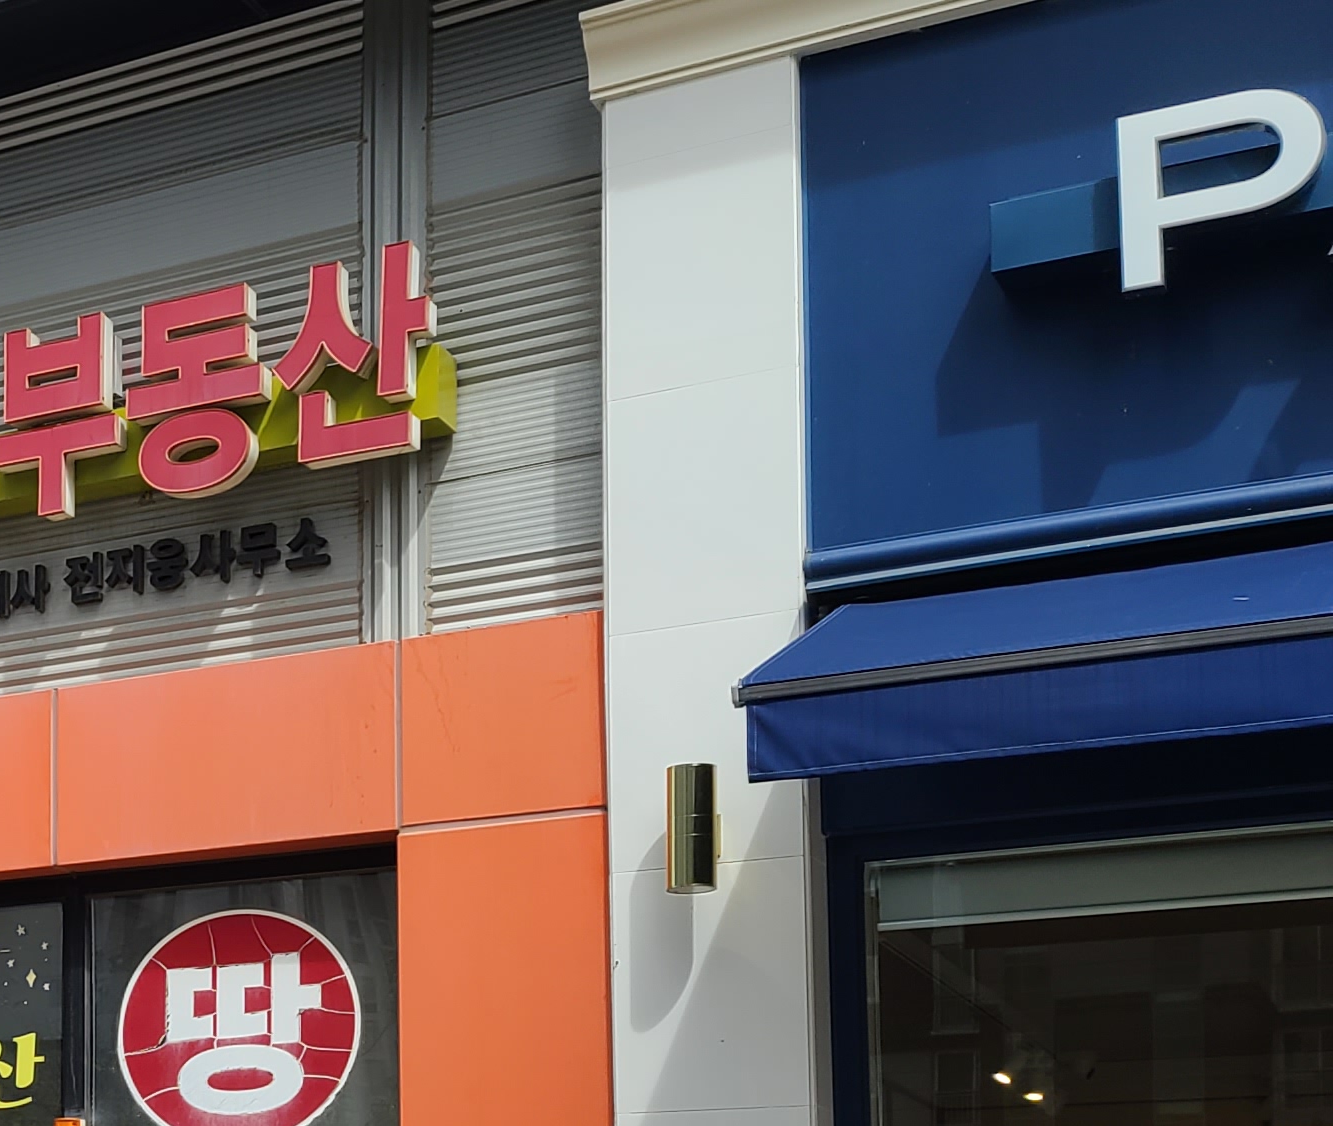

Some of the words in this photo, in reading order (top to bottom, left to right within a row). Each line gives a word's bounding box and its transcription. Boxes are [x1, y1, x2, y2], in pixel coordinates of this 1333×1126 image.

[1116, 87, 1333, 293] P
[63, 517, 332, 605] 전지웅사무소
[164, 951, 323, 1117] 땅
